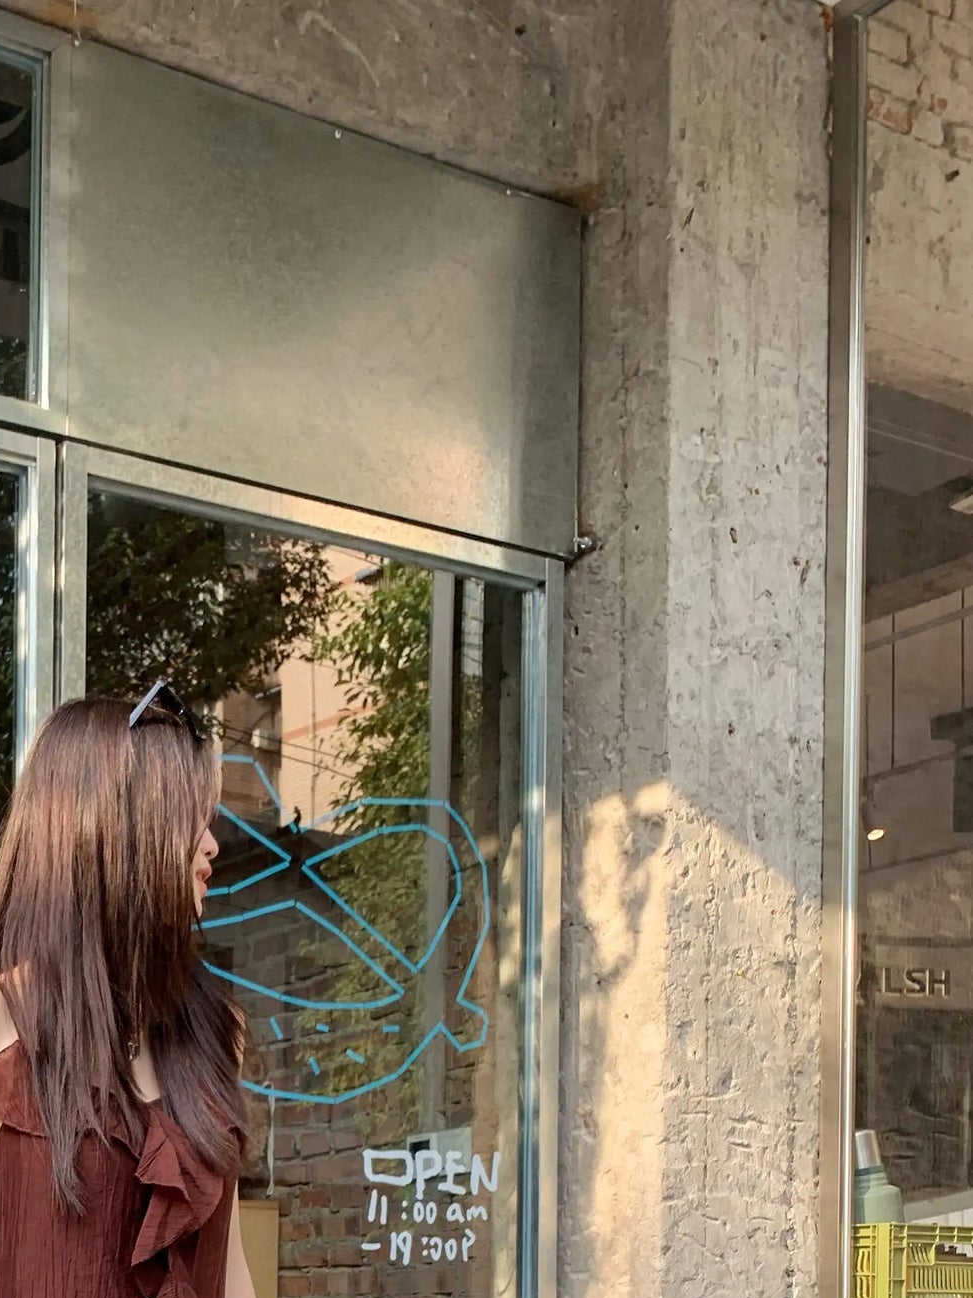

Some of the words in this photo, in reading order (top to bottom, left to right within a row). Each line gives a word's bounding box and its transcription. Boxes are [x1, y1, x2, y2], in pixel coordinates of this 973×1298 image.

[874, 966, 952, 998] LSH
[362, 1149, 502, 1200] OPEN
[445, 1202, 489, 1224] am
